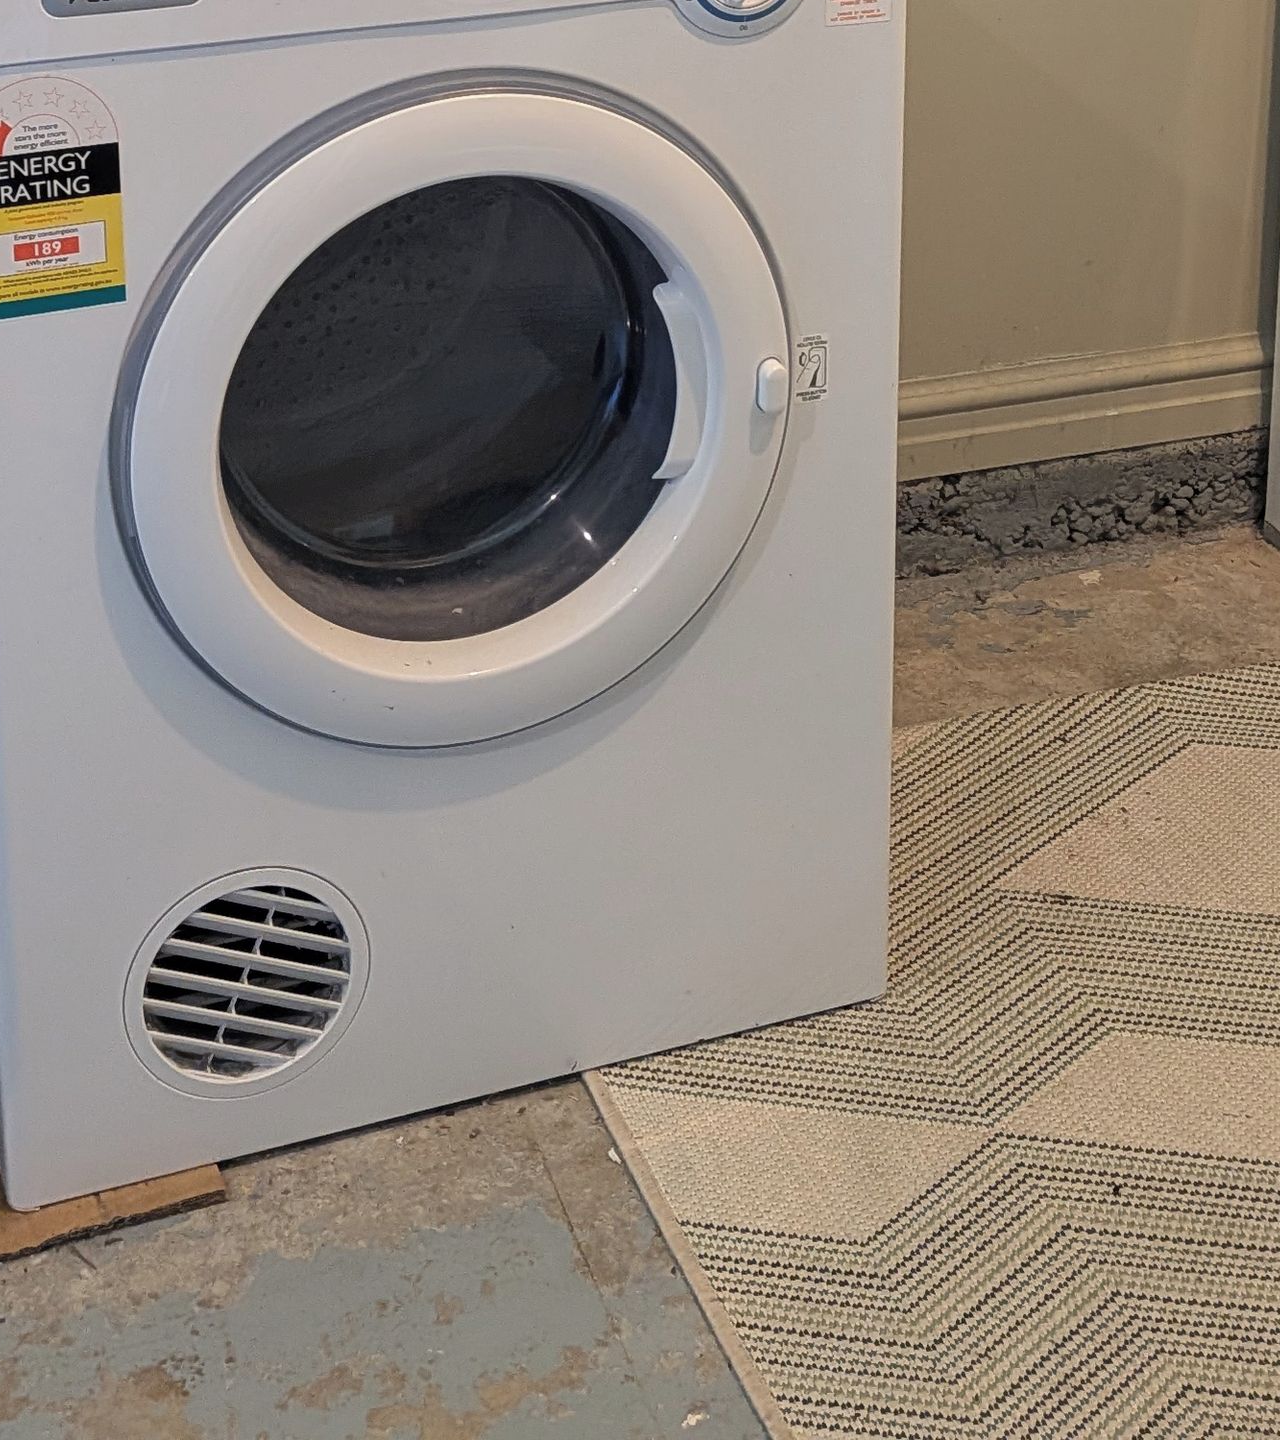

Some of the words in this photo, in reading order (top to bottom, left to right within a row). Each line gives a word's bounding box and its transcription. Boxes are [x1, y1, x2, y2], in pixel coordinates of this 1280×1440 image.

[22, 125, 38, 133] The
[38, 123, 58, 131] more
[14, 142, 39, 151] energy
[0, 175, 91, 204] RATING
[14, 234, 37, 242] Energy
[37, 228, 79, 237] consumption
[34, 241, 62, 257] 189
[42, 258, 54, 266] per
[54, 256, 69, 264] year
